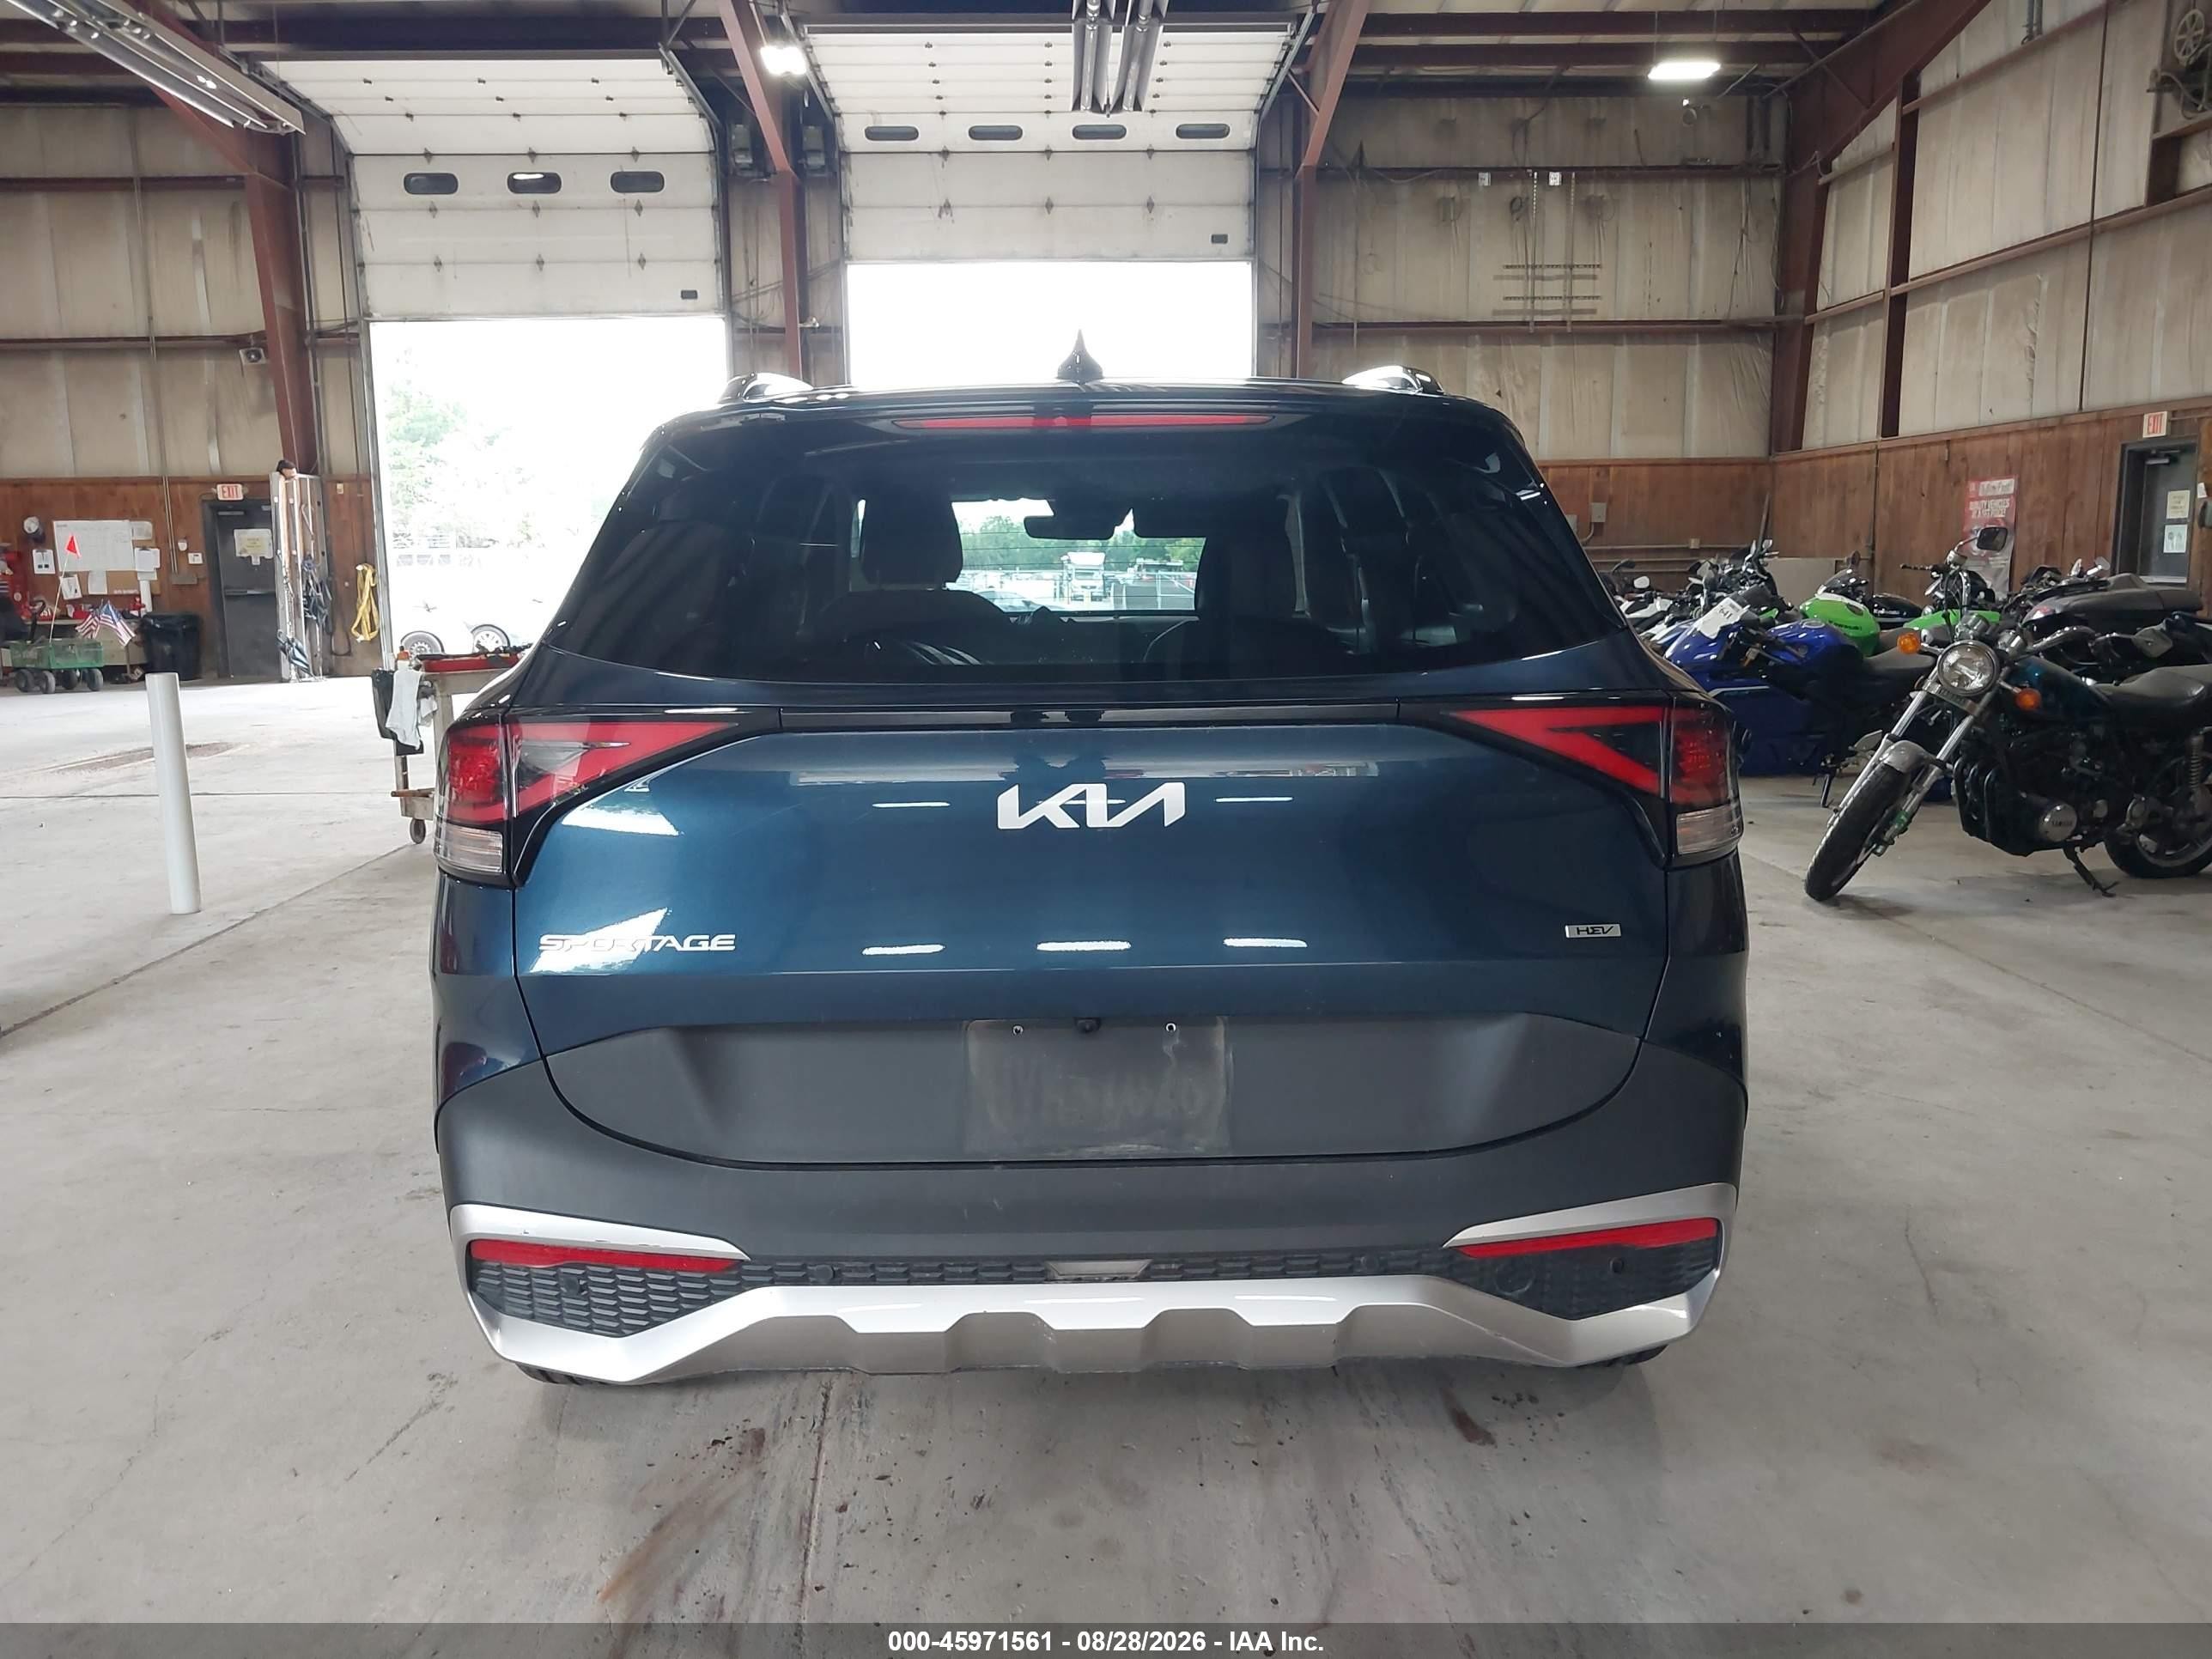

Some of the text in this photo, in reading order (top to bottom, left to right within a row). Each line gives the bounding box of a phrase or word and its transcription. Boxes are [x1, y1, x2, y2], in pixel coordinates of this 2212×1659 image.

[222, 485, 239, 498] EXIT
[1577, 927, 1613, 935] HEV
[538, 933, 736, 952] SPORTAGE
